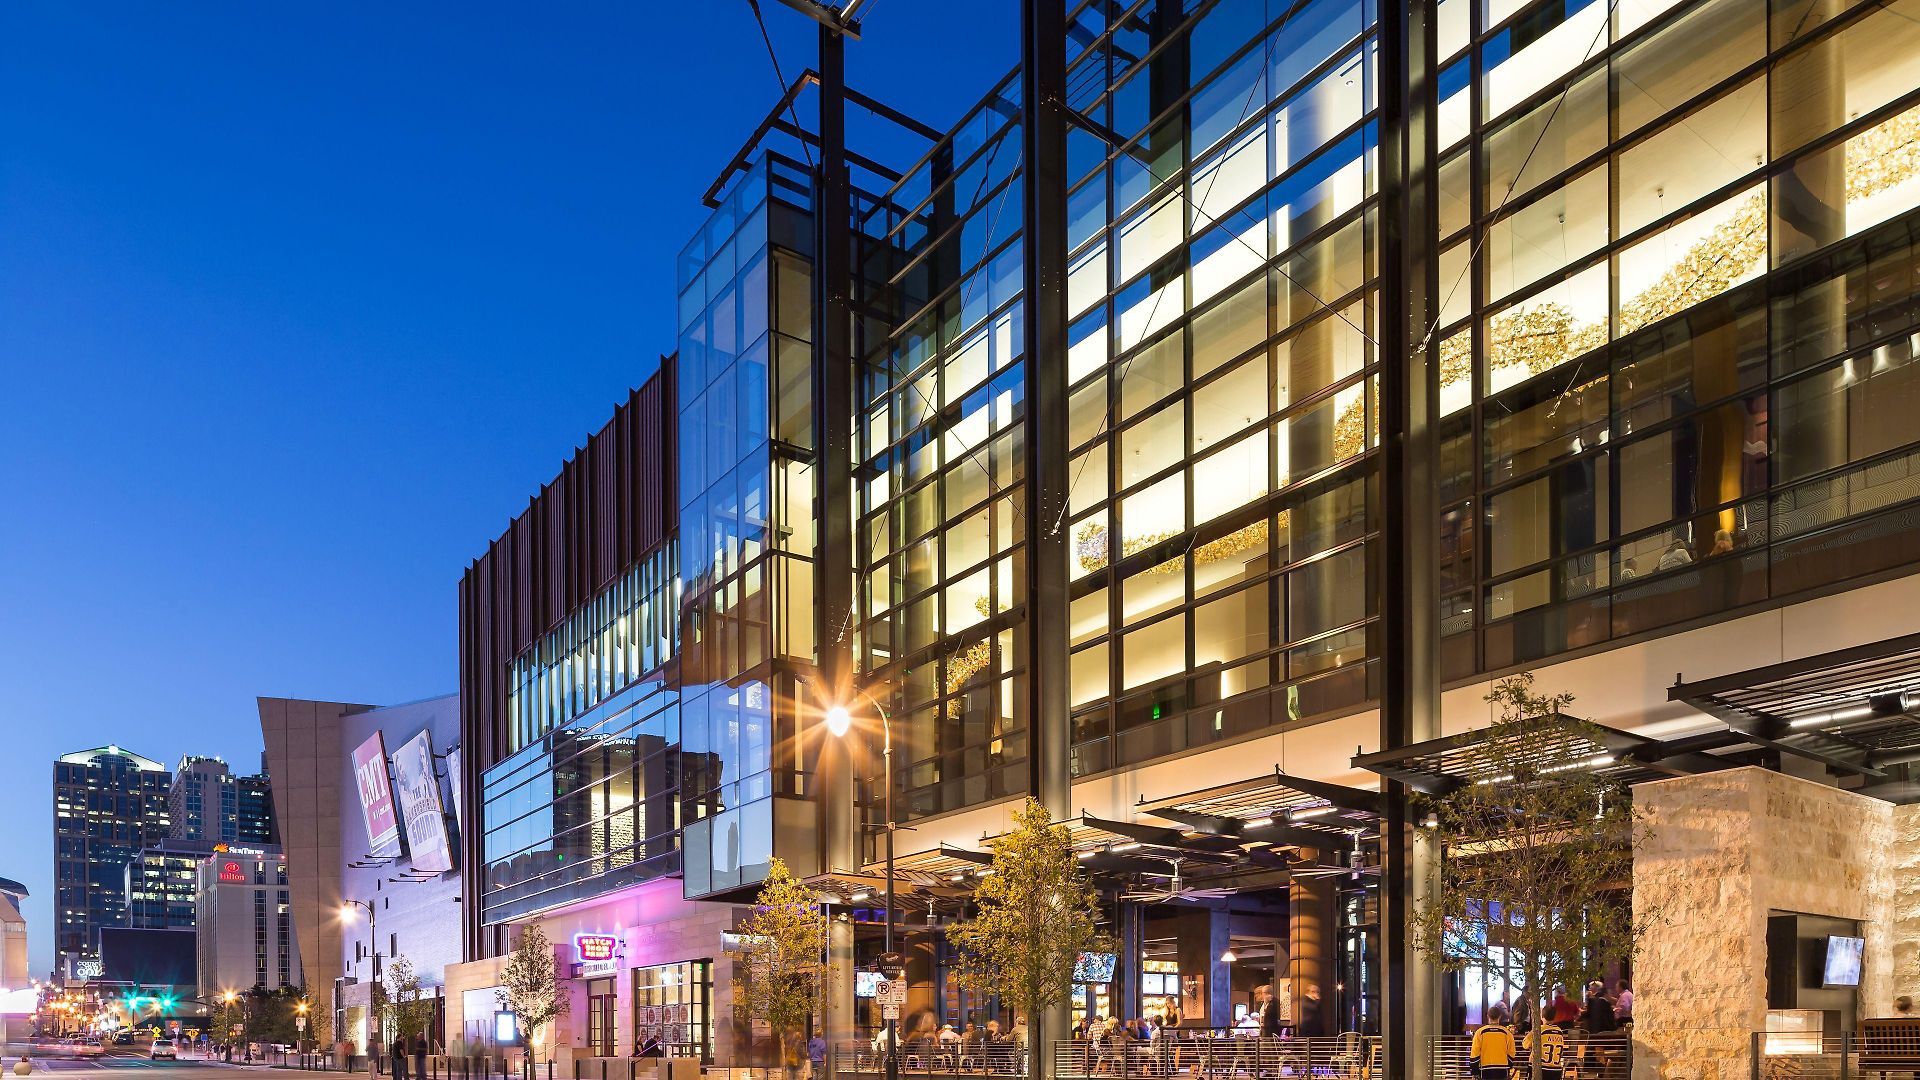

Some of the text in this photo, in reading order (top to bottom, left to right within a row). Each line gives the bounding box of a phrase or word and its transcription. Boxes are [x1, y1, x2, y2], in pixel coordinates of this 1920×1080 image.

[357, 752, 387, 808] CMT
[412, 814, 437, 846] SOUND
[220, 872, 245, 881] Hilton
[1541, 1043, 1563, 1065] 33
